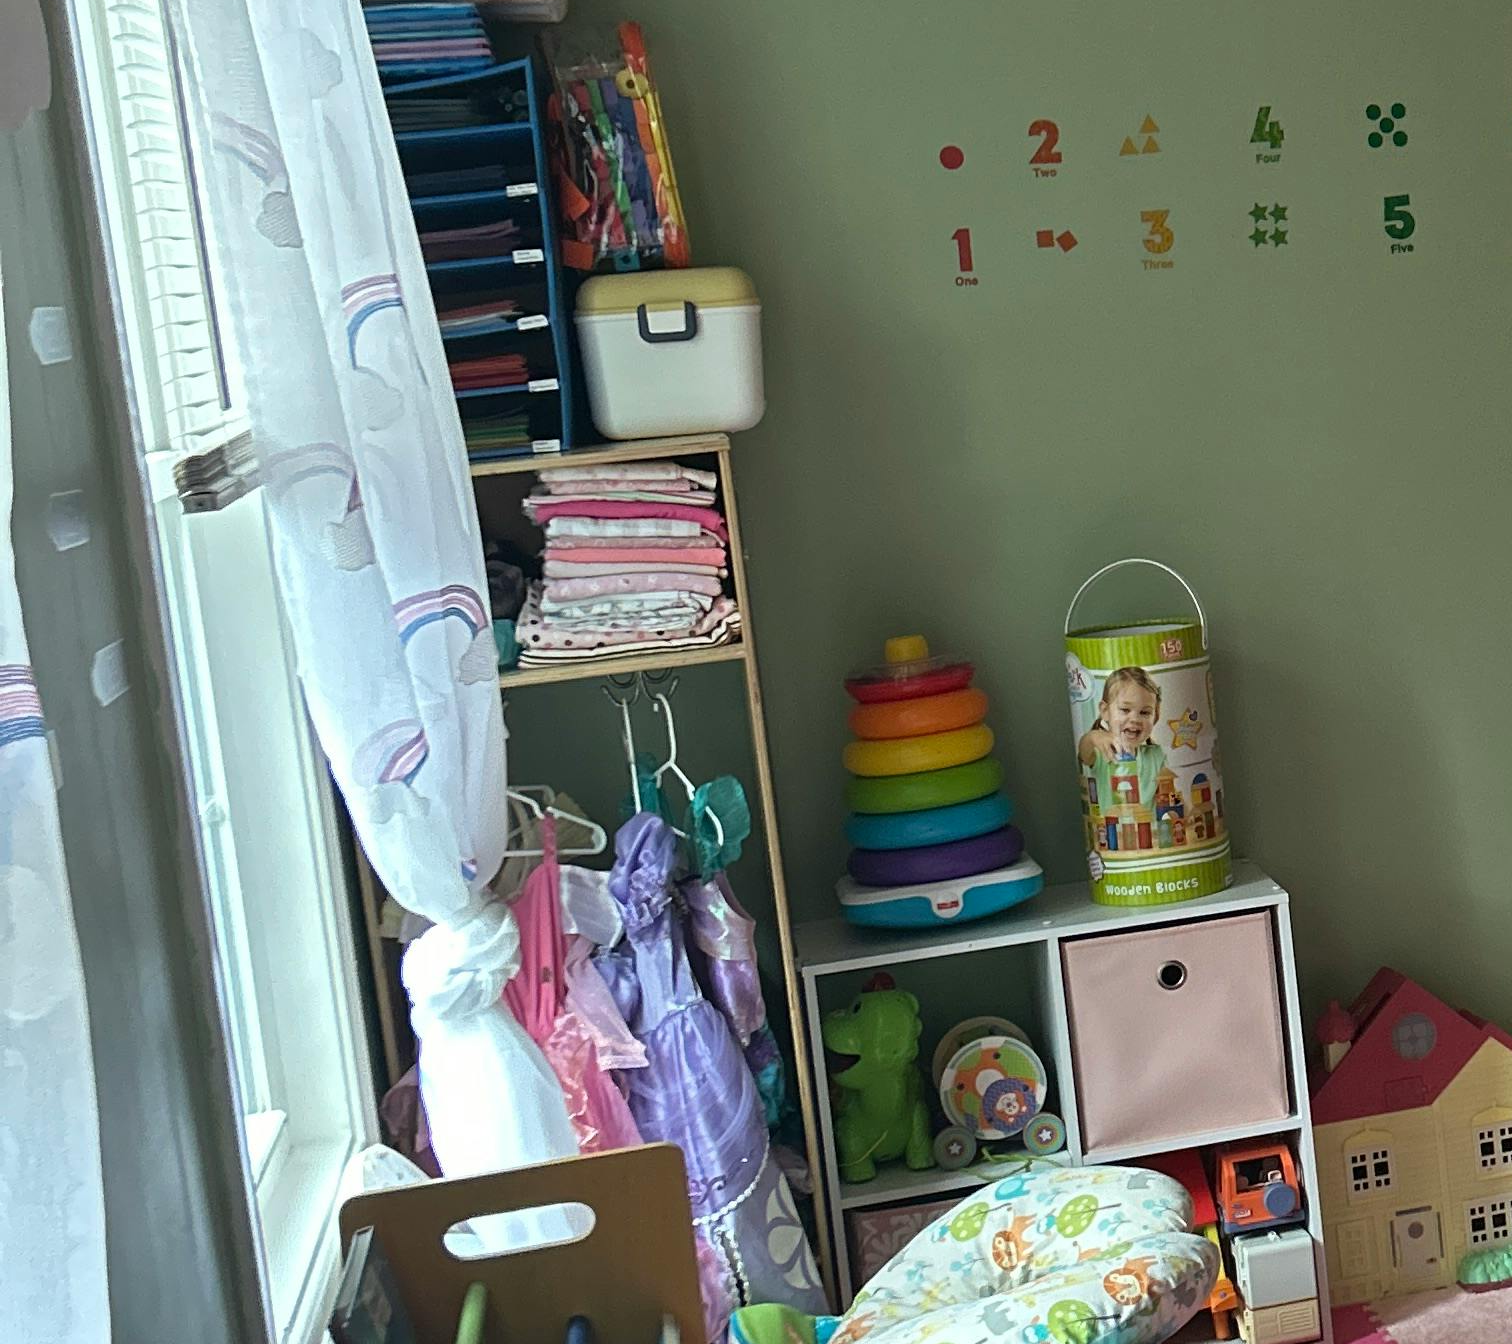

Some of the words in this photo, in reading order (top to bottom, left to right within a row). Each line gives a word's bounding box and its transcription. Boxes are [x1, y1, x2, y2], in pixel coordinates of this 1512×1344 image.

[1249, 105, 1285, 150] 4
[1028, 119, 1063, 165] 2
[1255, 153, 1281, 165] Four
[1032, 167, 1057, 179] Two
[1384, 194, 1416, 241] 5
[1140, 208, 1175, 254] 3
[951, 227, 973, 273] 1
[1391, 242, 1414, 255] Five
[1141, 259, 1175, 271] Three
[955, 275, 979, 288] One
[1159, 640, 1183, 654] 150
